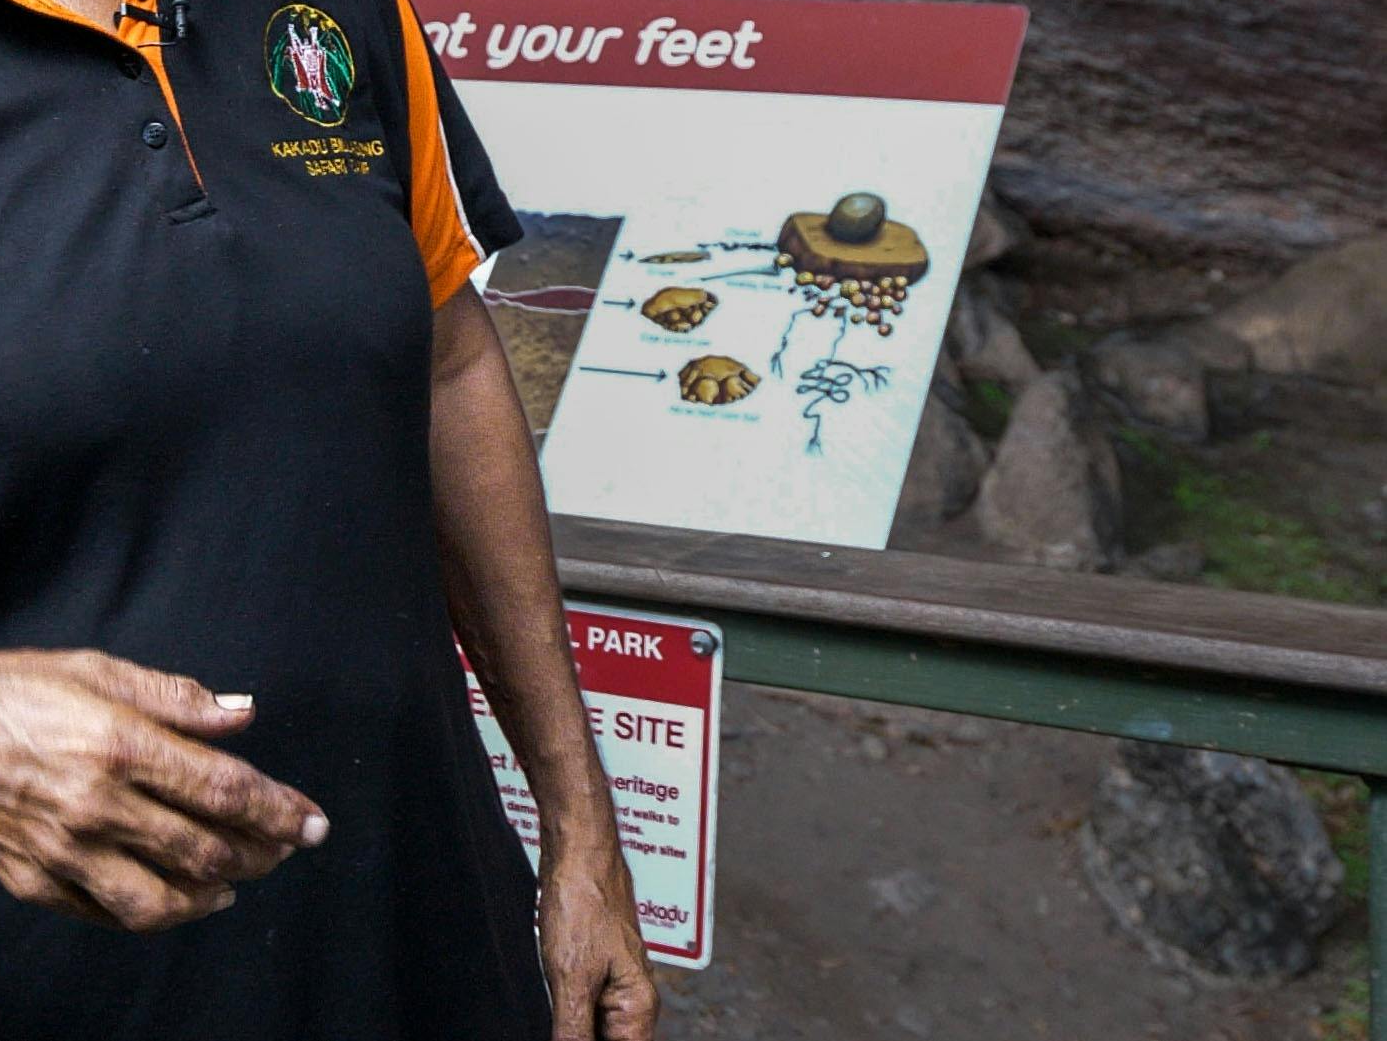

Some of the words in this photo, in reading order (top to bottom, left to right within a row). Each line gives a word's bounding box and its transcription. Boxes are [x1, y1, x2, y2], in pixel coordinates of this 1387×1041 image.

[486, 21, 623, 70] your
[635, 17, 763, 69] feet
[587, 626, 664, 660] PARK
[614, 712, 685, 749] SITE
[610, 775, 680, 802] eritage
[637, 900, 690, 924] akadu
